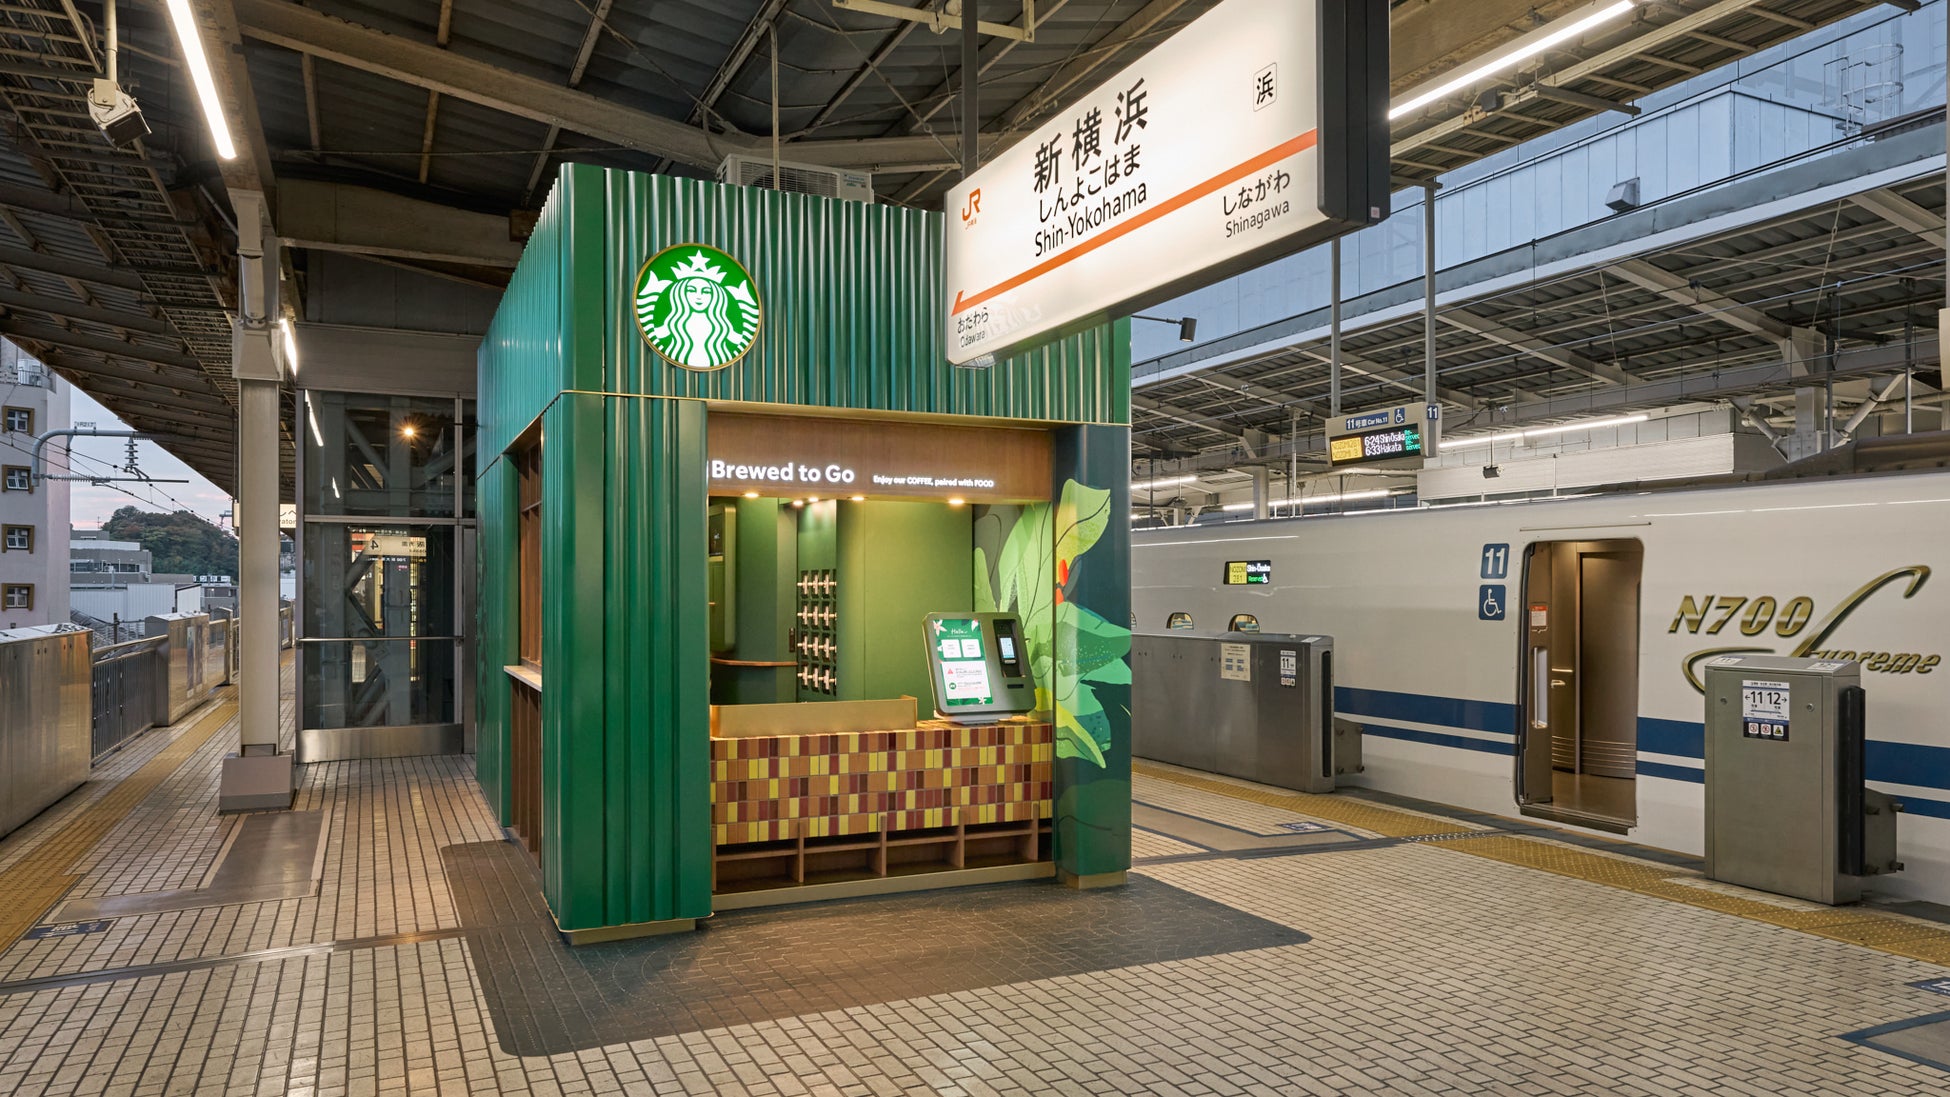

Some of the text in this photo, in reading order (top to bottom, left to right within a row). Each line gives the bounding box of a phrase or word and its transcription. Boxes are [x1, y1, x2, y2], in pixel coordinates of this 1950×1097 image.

[1256, 71, 1274, 105] 浜
[1033, 77, 1149, 194] 新横浜
[1039, 144, 1141, 223] しんよこはま
[1223, 169, 1291, 216] しながわ
[962, 188, 981, 221] JR
[1035, 182, 1147, 258] Shin-Yokohama
[1225, 200, 1290, 238] Shinagawa
[957, 307, 989, 334] おだわら
[1427, 406, 1438, 419] 11
[1380, 442, 1402, 453] Hakata
[711, 460, 855, 482] Brewed to Go
[873, 475, 893, 485] Enjoy
[893, 476, 906, 484] our
[934, 478, 957, 488] paired
[958, 478, 974, 487] with
[974, 479, 994, 487] FOOD
[1485, 547, 1505, 574] 11
[1668, 595, 1813, 637] N700
[1750, 691, 1781, 705] 11 12
